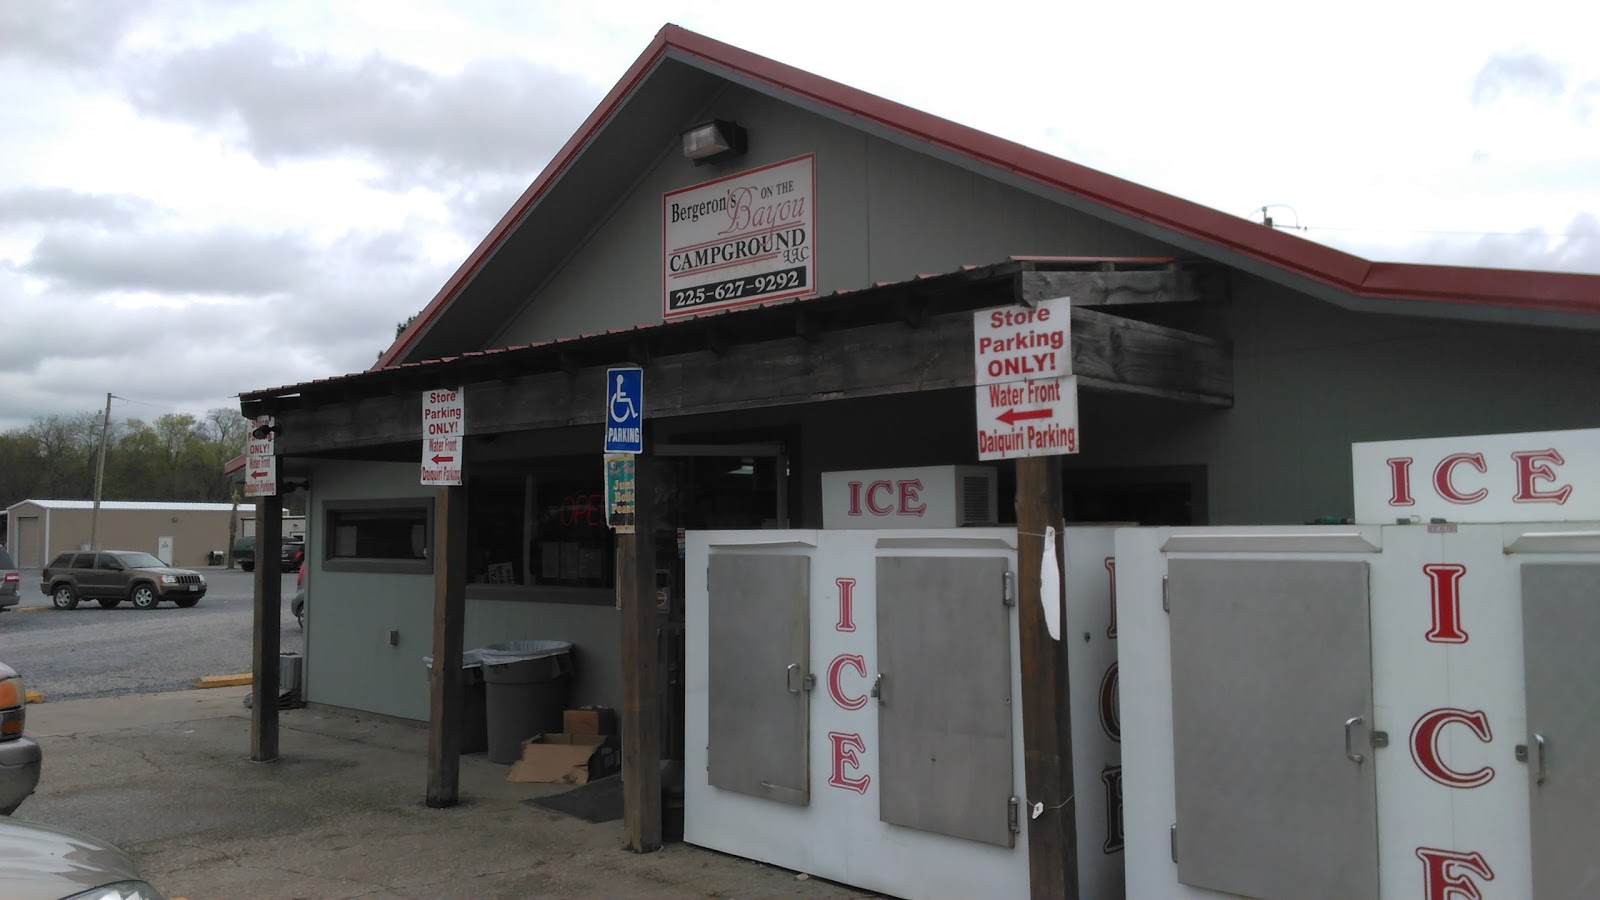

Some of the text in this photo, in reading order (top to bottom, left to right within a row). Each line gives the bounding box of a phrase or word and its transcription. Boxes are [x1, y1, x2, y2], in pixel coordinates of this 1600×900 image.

[760, 180, 794, 199] ON THE
[671, 189, 736, 223] Bergeron's
[717, 186, 805, 245] Bayou
[669, 228, 806, 272] CAMPGROUND
[783, 246, 809, 264] LLC
[675, 271, 799, 307] 225-627-9292
[990, 307, 1050, 329] Store
[979, 330, 1063, 355] Parking
[988, 352, 1056, 377] ONLY!
[430, 392, 456, 404] Store
[989, 378, 1061, 408] Water Front
[424, 406, 462, 420] Parking
[428, 421, 459, 435] ONLY!
[608, 427, 640, 443] PARKING
[979, 423, 1075, 457] Daiquiri Parking
[250, 443, 270, 454] ONLY!
[429, 438, 457, 452] Water Front
[422, 465, 461, 484] Daiquiri Parking
[1386, 448, 1573, 507] ICE
[848, 478, 927, 517] ICE
[560, 493, 605, 528] OPE
[826, 577, 871, 795] ICE
